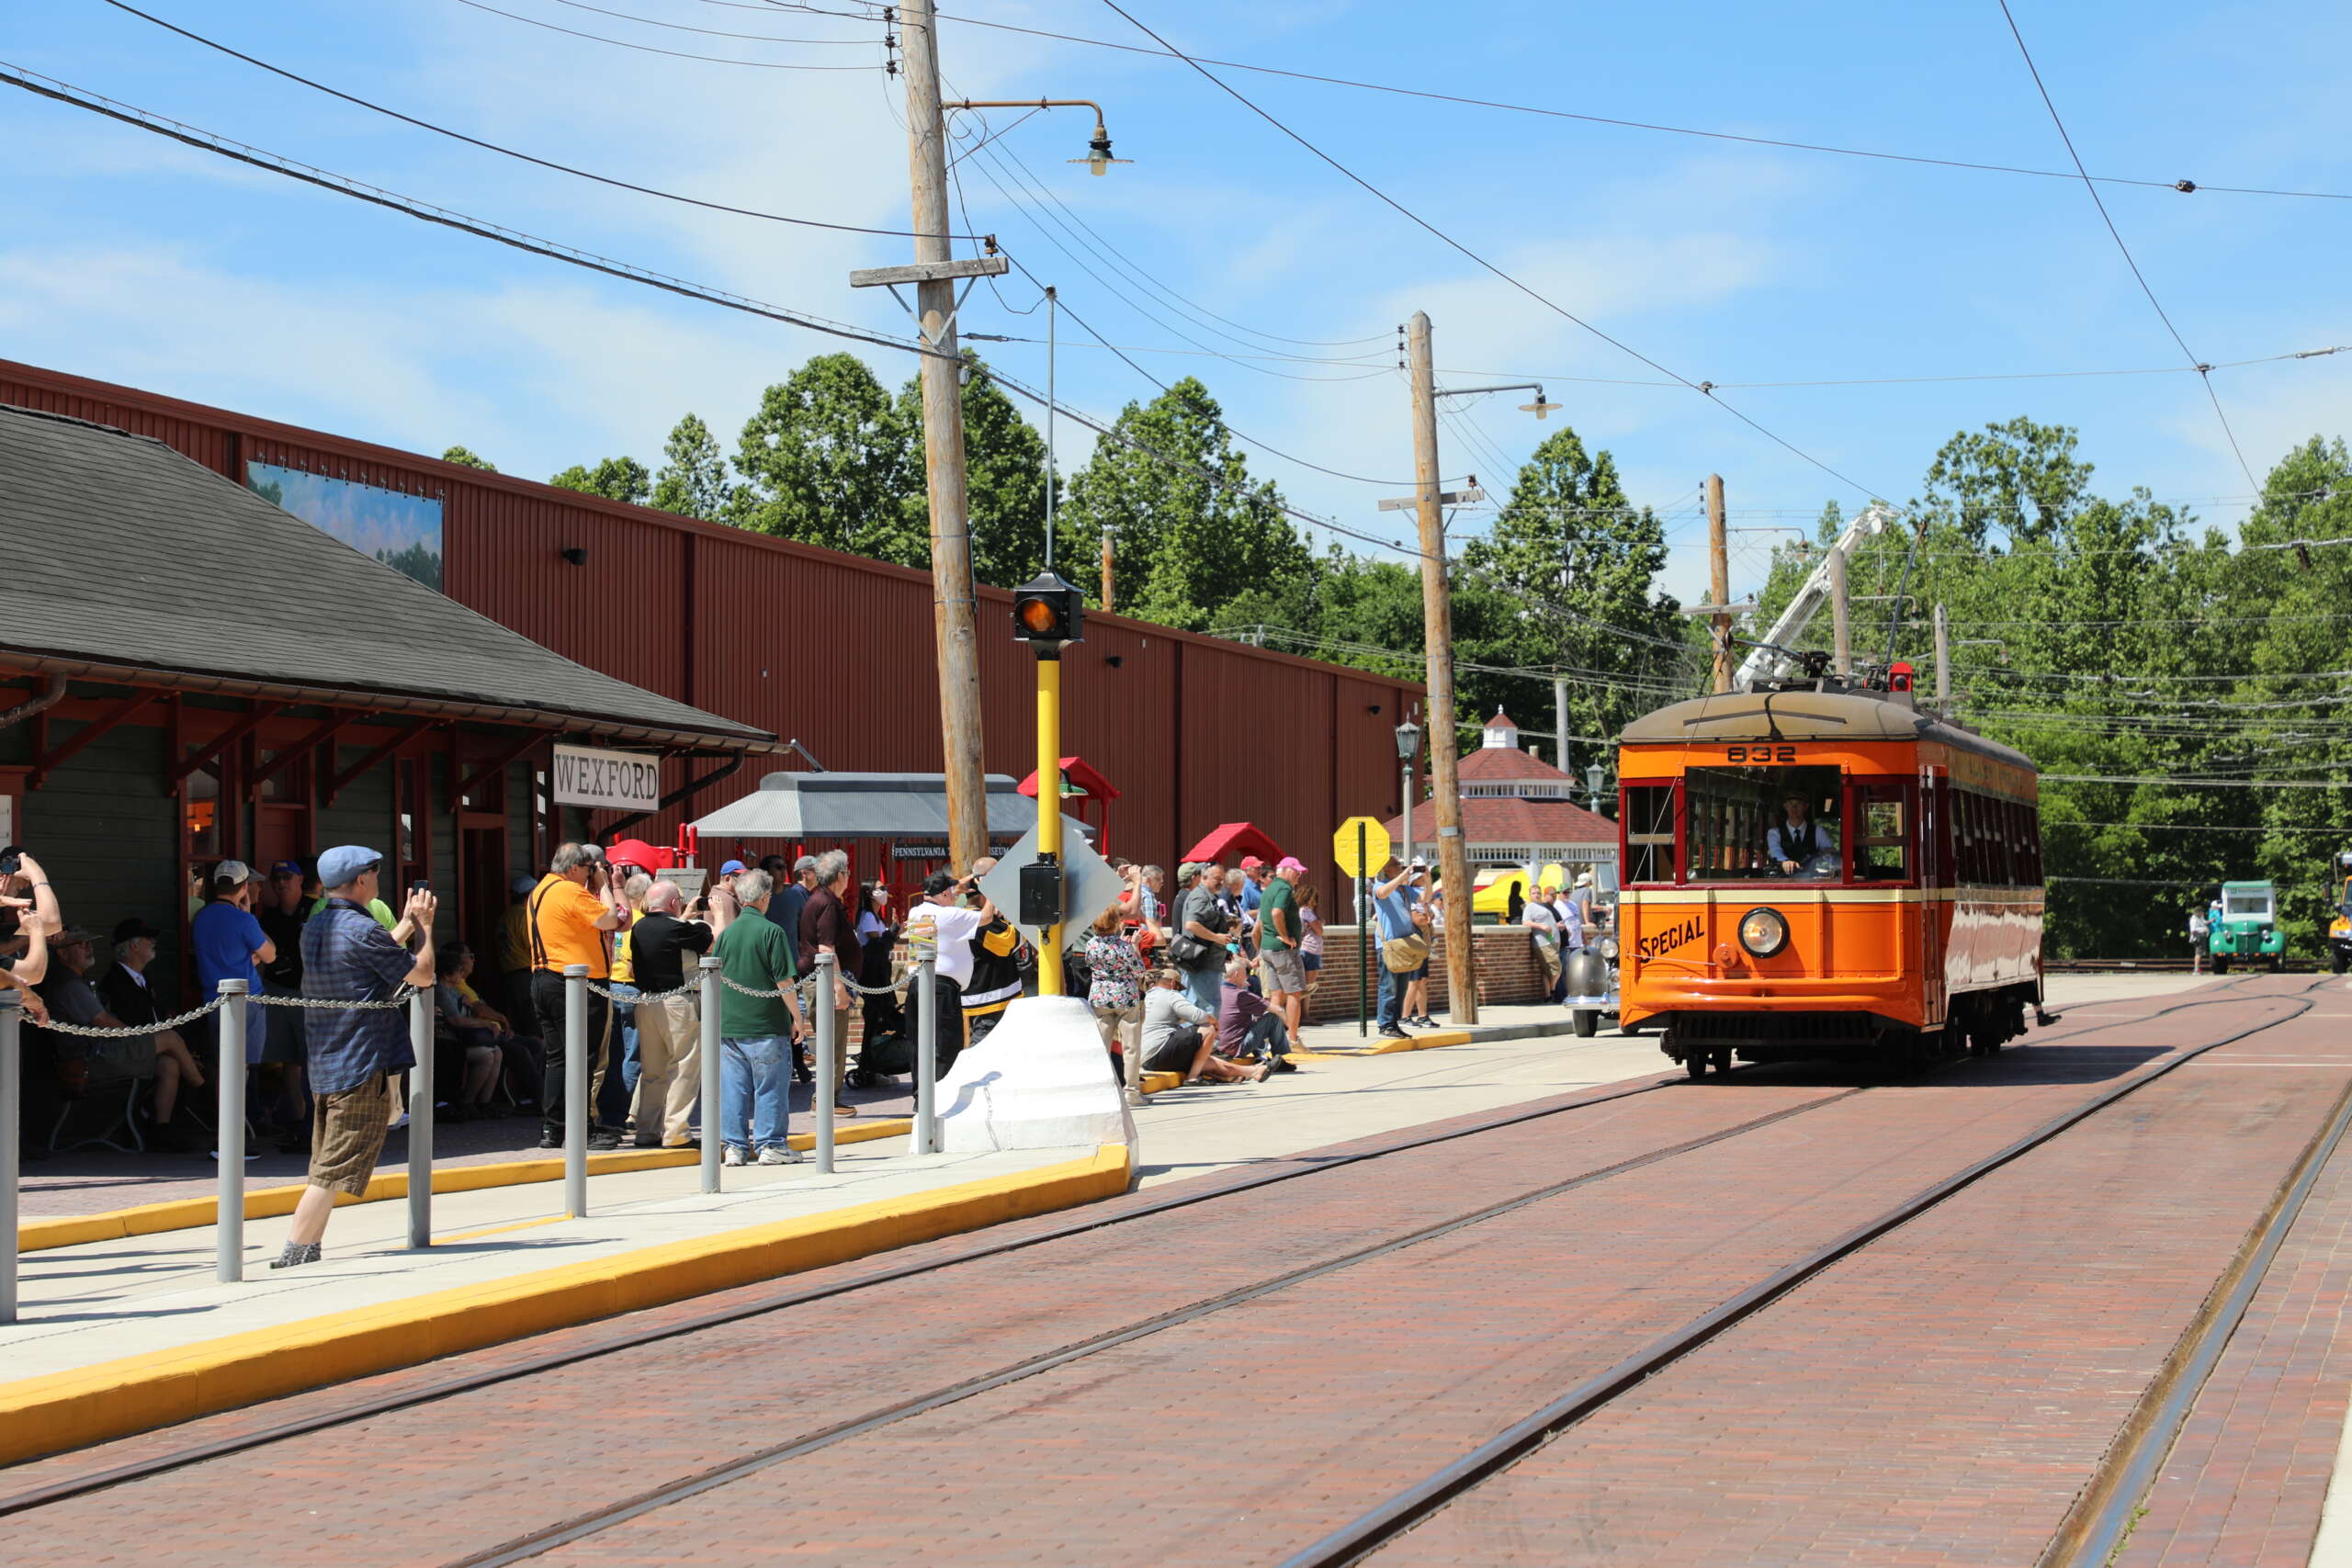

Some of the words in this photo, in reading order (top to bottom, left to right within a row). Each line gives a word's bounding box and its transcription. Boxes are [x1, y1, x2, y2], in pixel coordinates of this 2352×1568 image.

[1728, 747, 1795, 762] 832
[555, 754, 658, 800] WEXFORD
[895, 846, 946, 857] PENNSYLVANIA
[1639, 915, 1705, 964] SPECIAL
